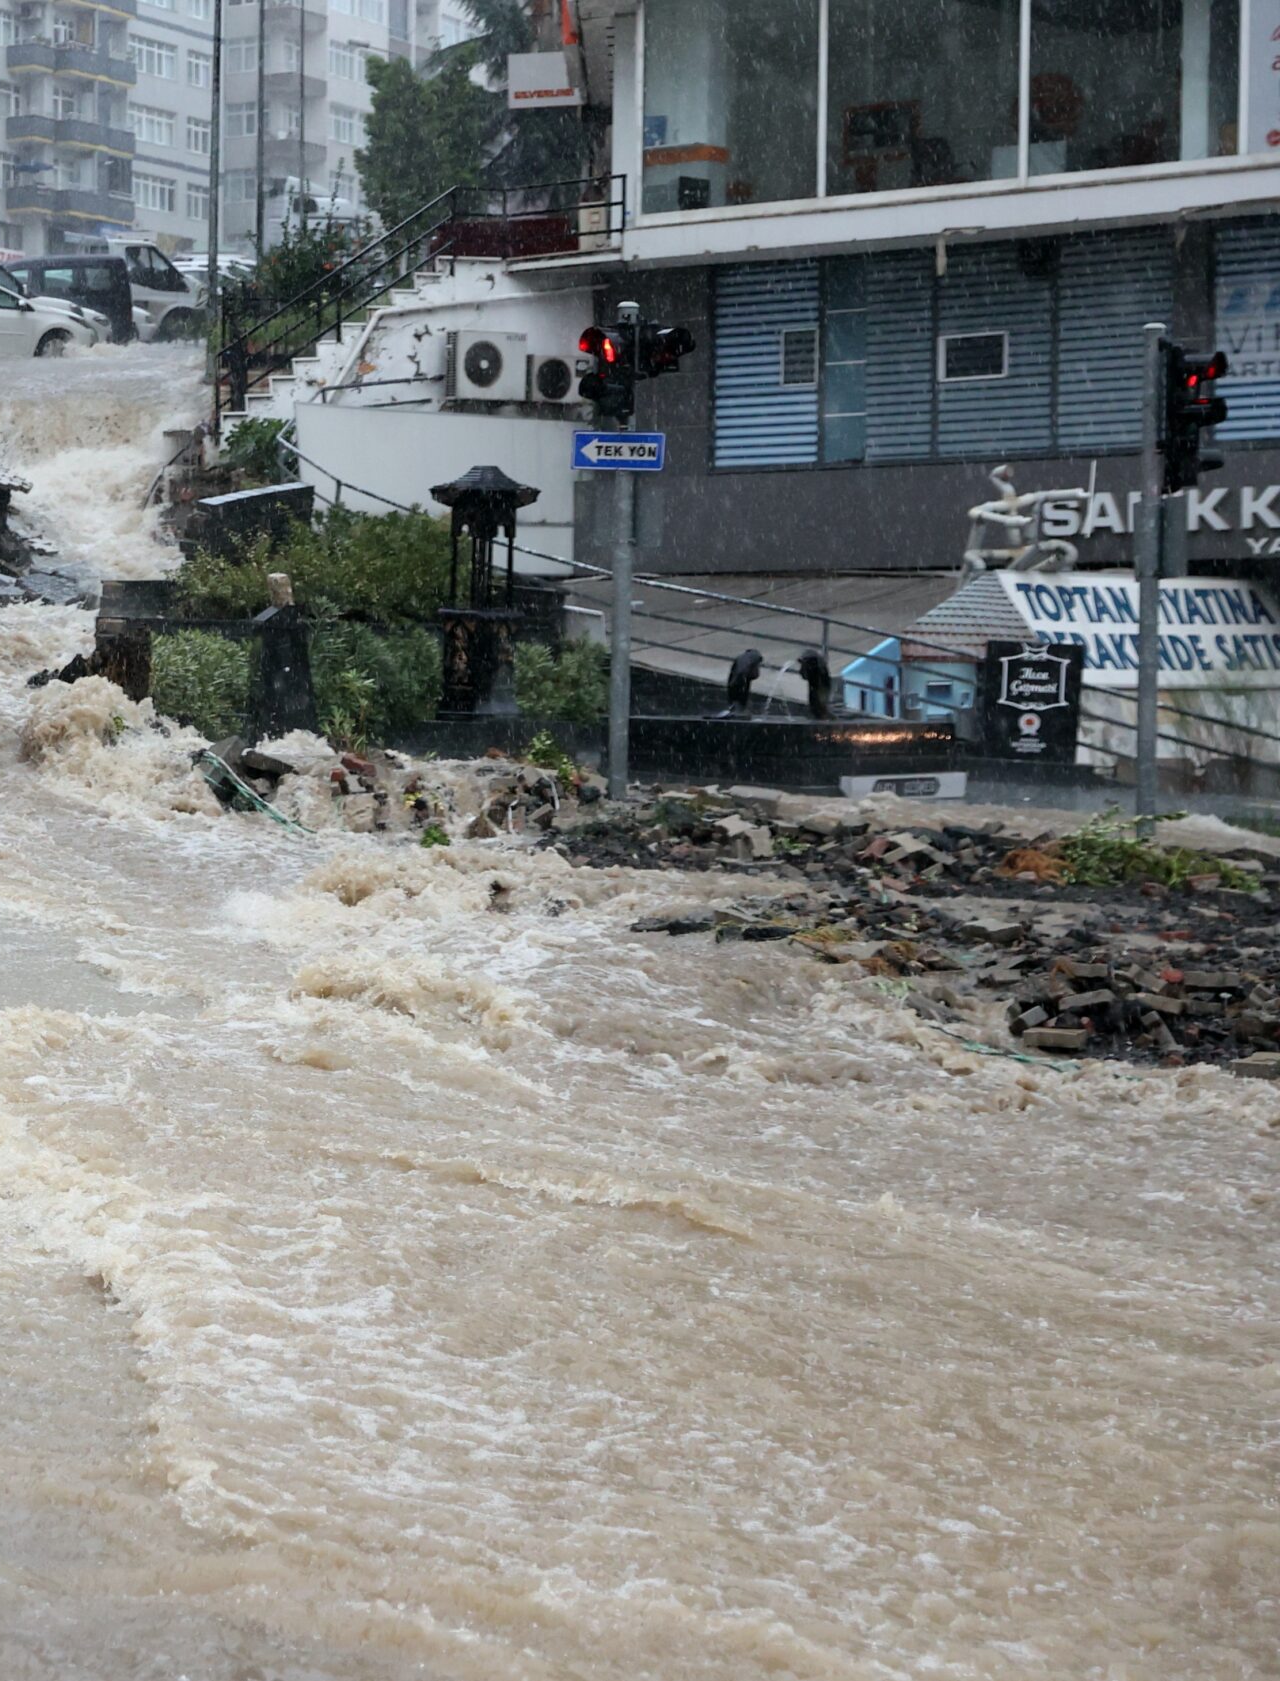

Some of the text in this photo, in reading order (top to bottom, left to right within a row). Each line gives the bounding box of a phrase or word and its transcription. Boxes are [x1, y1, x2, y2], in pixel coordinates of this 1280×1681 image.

[595, 443, 657, 458] TEK YÖN
[1016, 583, 1140, 623] TOPTAN
